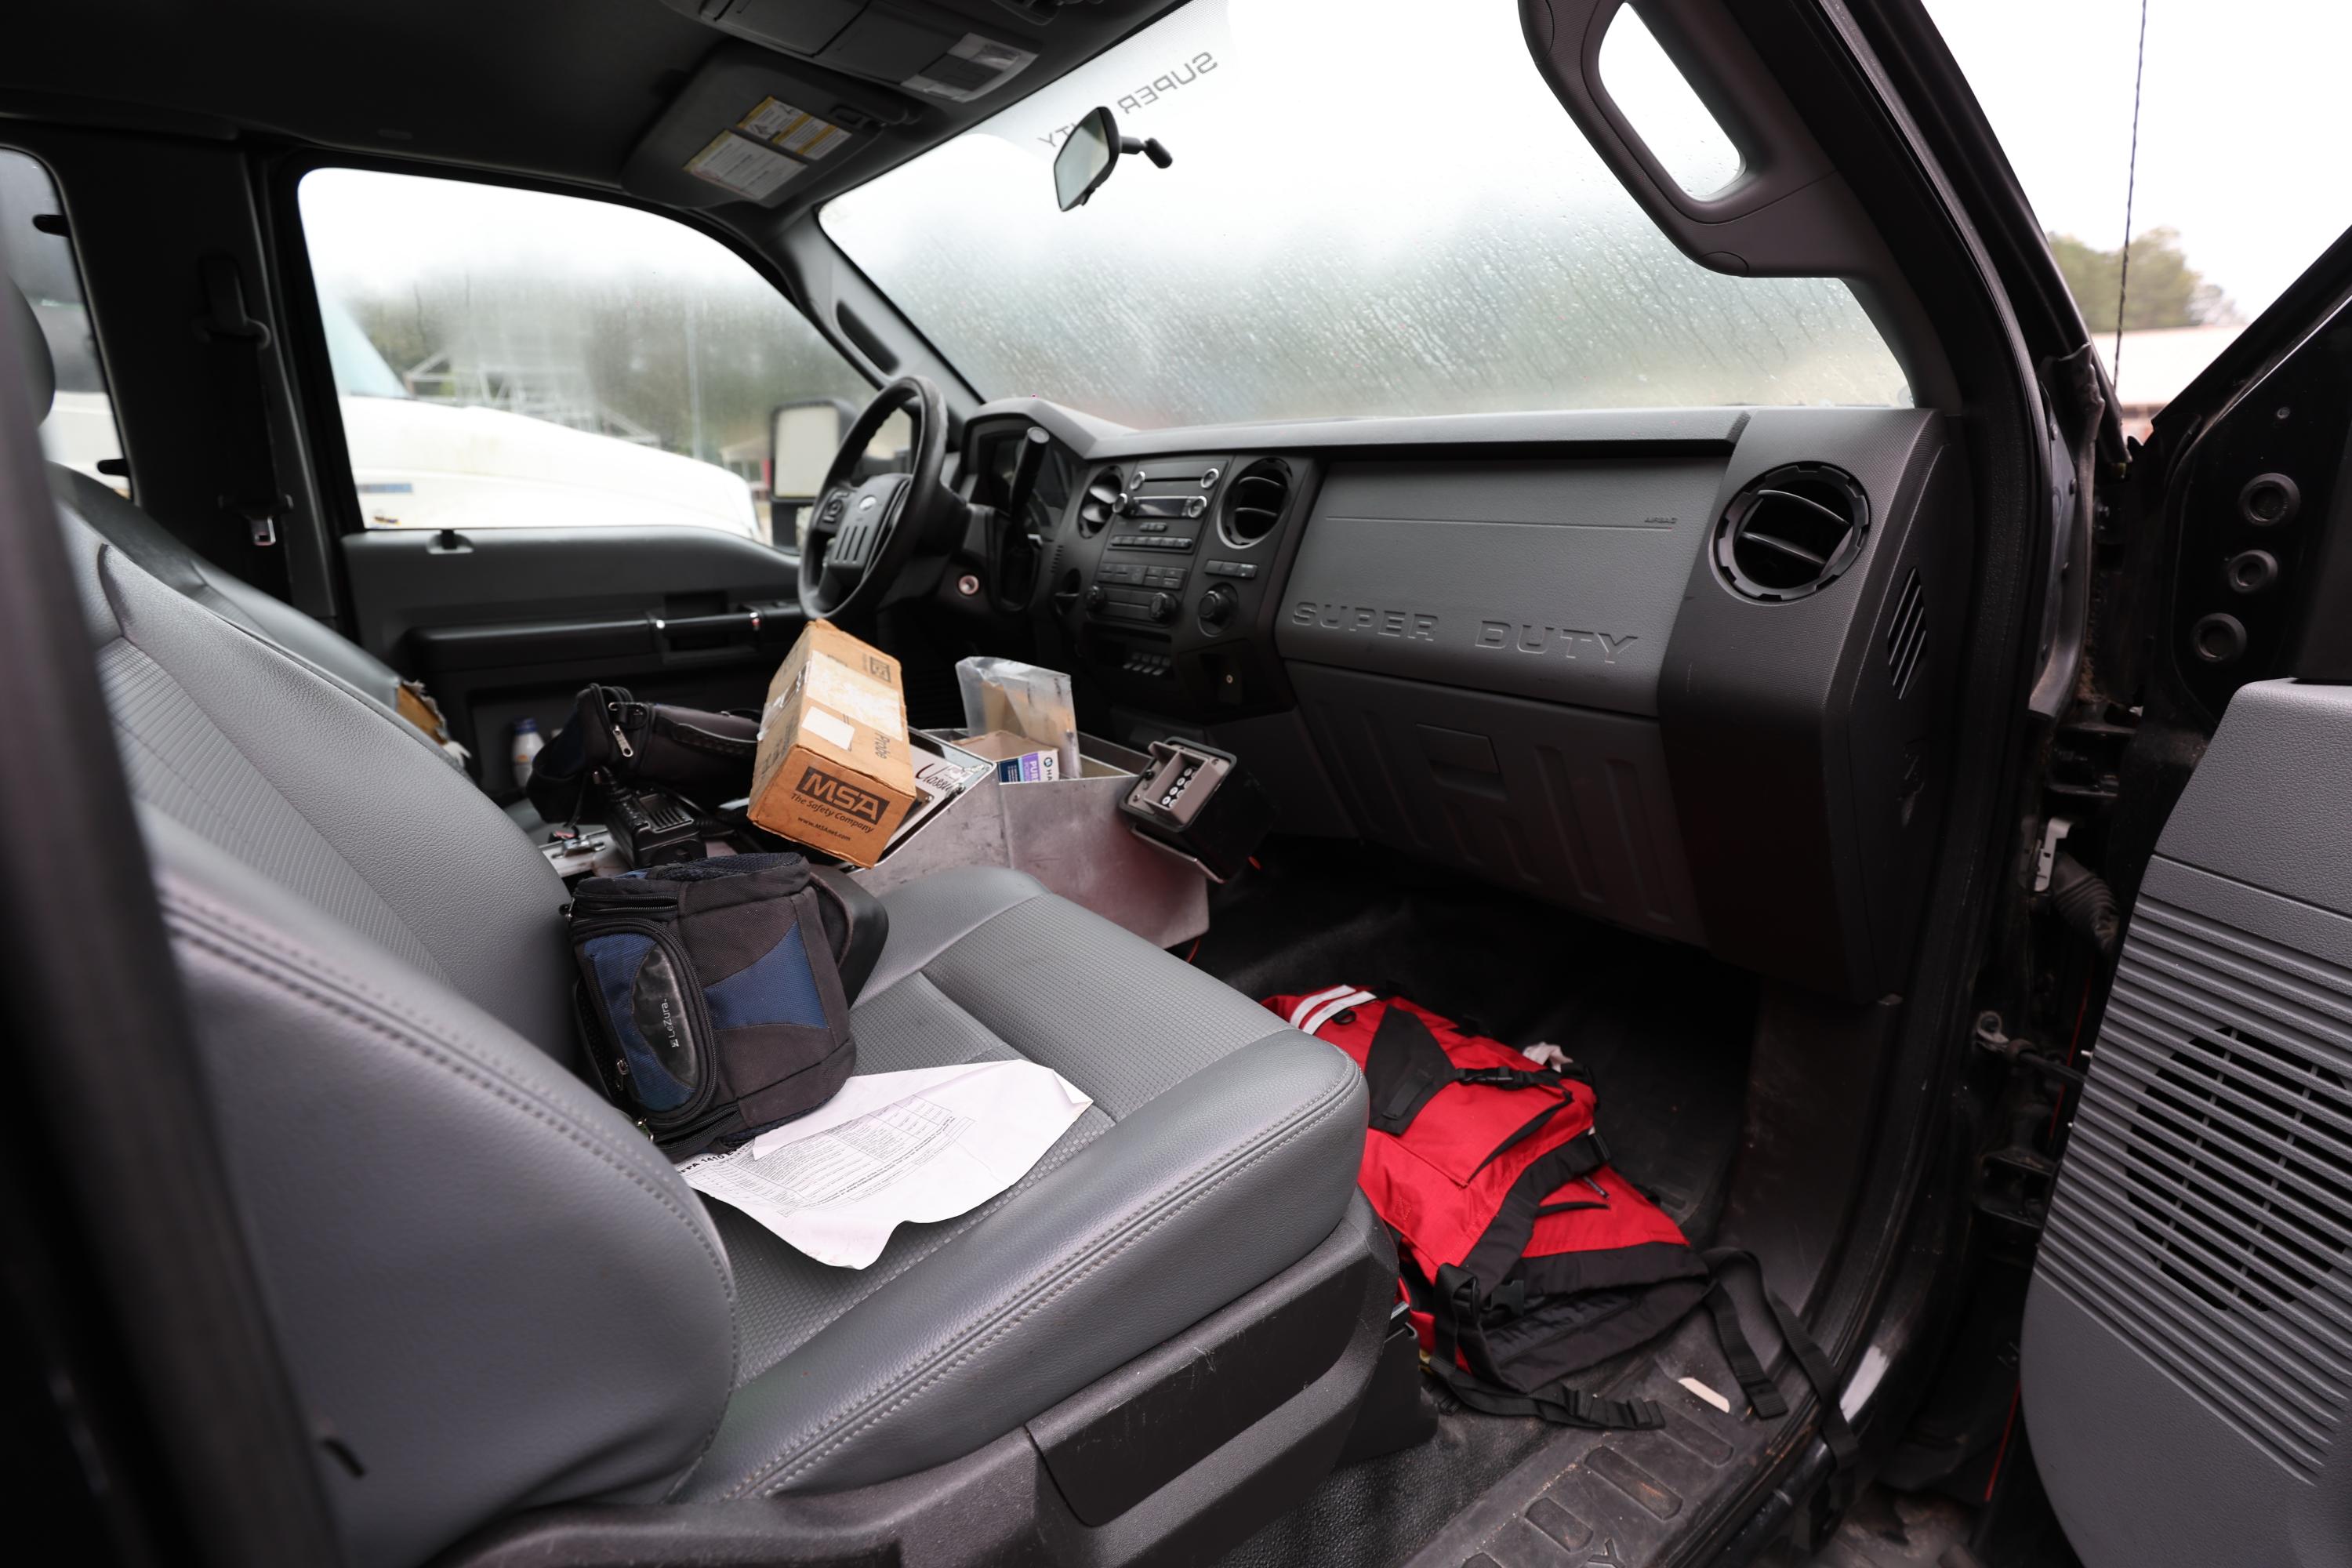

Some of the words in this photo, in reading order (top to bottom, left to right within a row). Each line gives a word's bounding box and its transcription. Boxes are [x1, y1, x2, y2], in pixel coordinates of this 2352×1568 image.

[1292, 601, 1439, 641] SUPER
[1475, 620, 1639, 663] DUTY
[791, 793, 807, 804] The
[807, 800, 834, 817] Safety
[834, 812, 874, 833] Company
[802, 773, 879, 821] MSA
[797, 817, 851, 841] www.MSAnet.com
